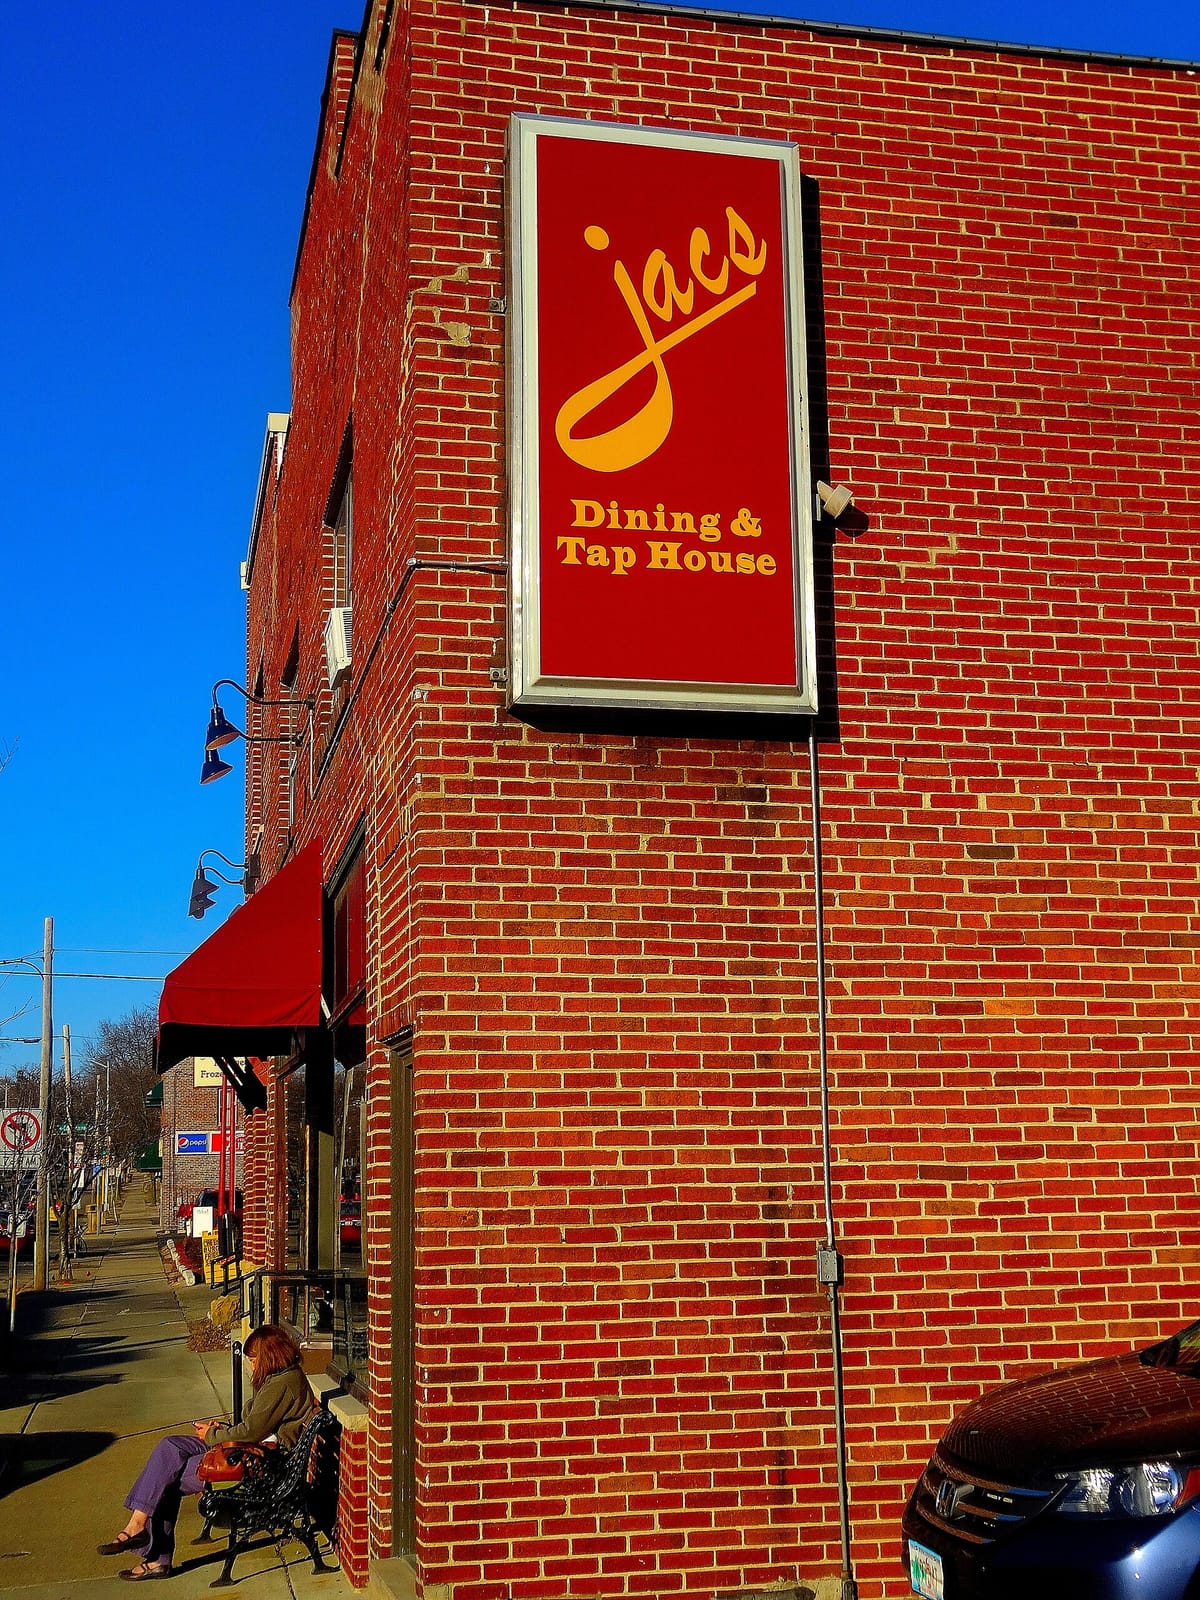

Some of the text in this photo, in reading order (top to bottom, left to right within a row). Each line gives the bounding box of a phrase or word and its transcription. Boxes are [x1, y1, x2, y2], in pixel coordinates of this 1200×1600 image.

[555, 206, 767, 473] jacs
[570, 498, 762, 542] Dining &
[556, 536, 777, 576] Tap House
